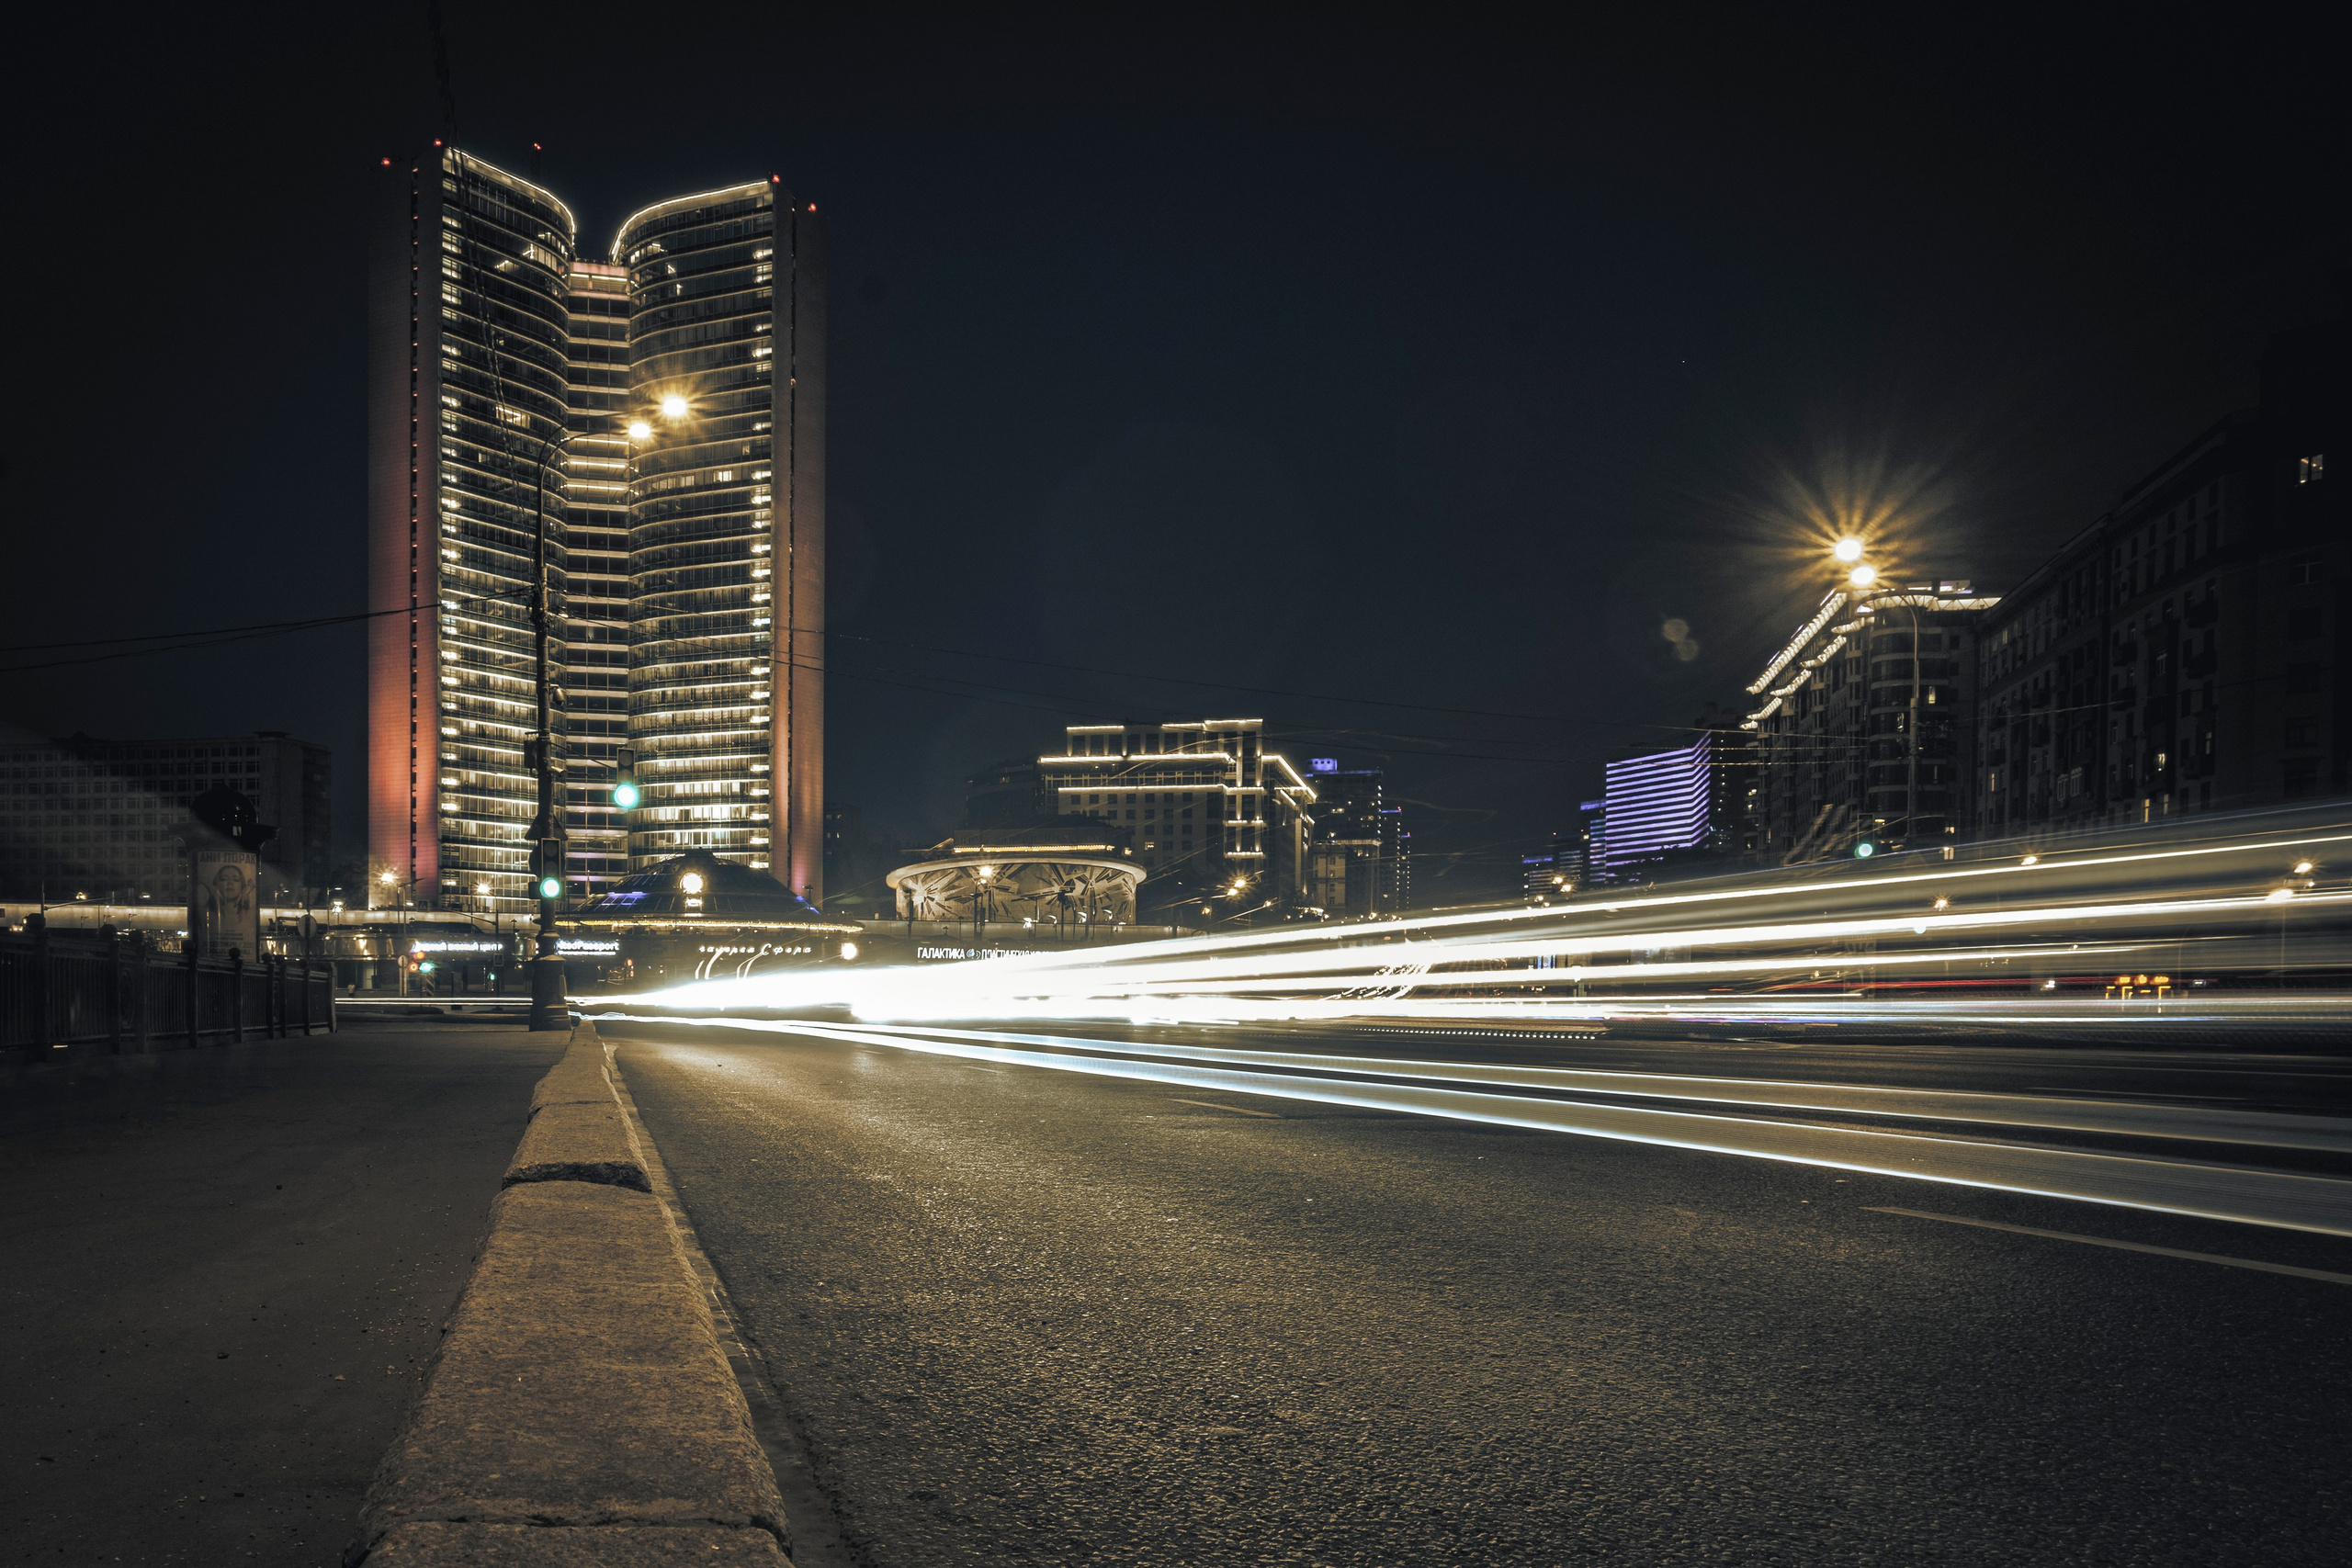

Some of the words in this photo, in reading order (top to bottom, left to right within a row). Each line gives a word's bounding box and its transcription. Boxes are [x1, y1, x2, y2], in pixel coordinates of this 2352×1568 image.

[199, 852, 221, 863] АНИ
[223, 852, 256, 864] ЛОРАК
[917, 947, 966, 959] ГАЛАКТИКА
